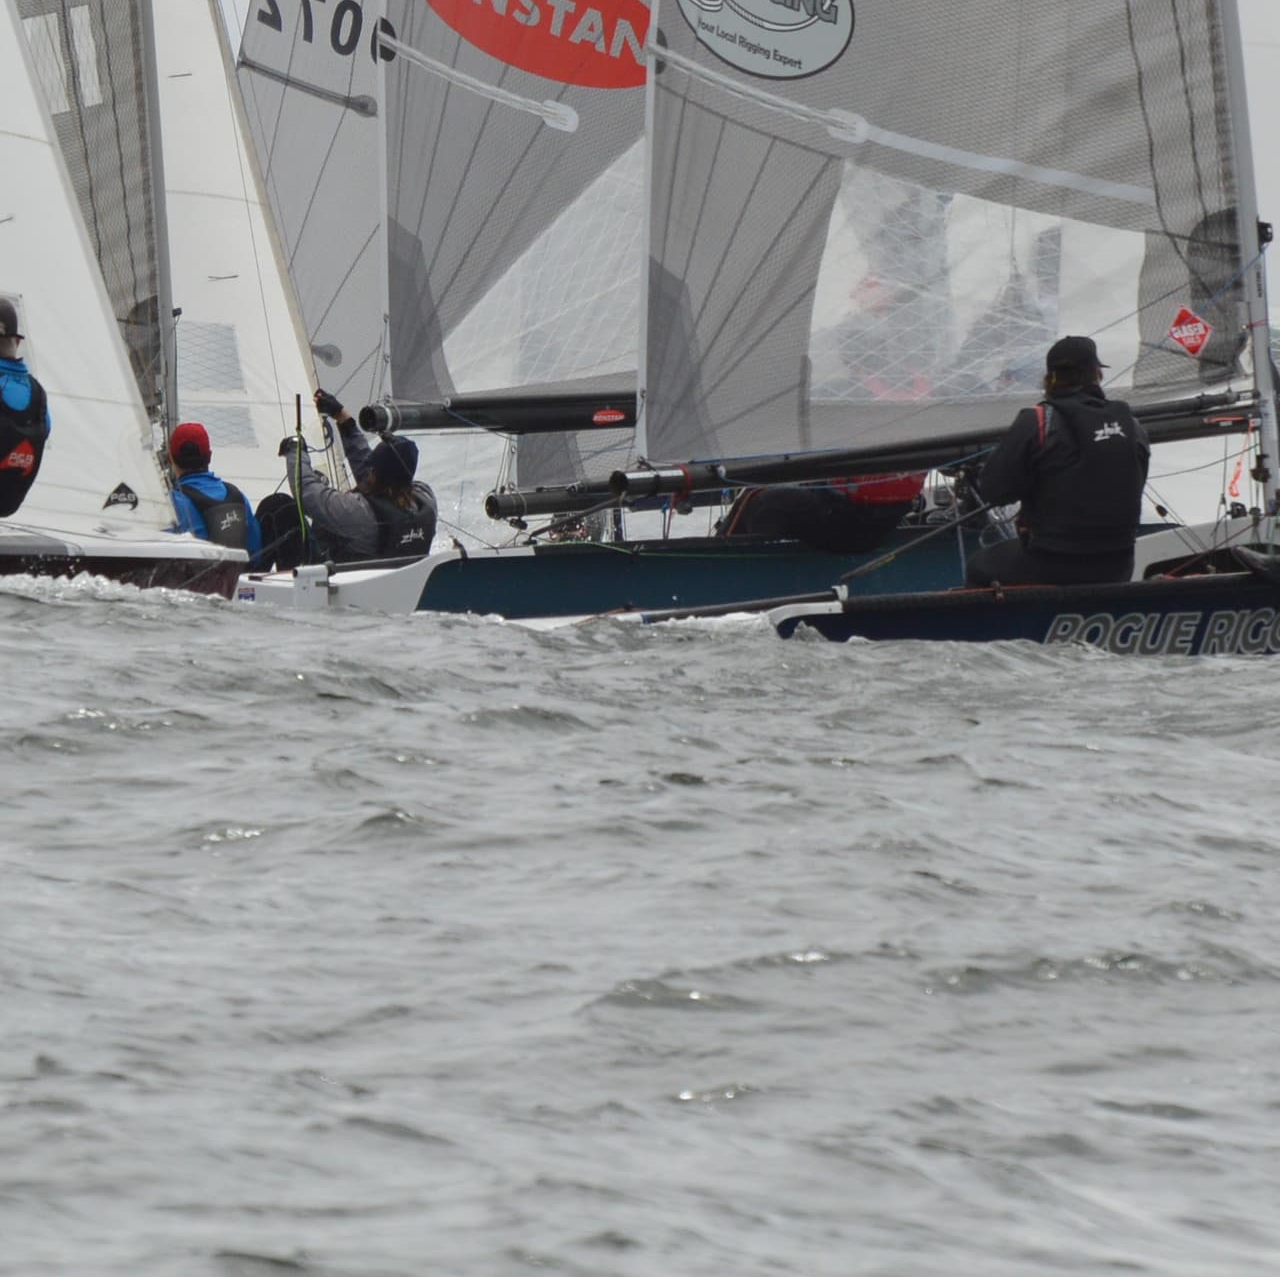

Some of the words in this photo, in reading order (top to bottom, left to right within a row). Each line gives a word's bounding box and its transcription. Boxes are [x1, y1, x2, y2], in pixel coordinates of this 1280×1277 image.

[716, 26, 737, 44] Local
[738, 35, 771, 60] Rigging
[773, 48, 802, 70] Expert
